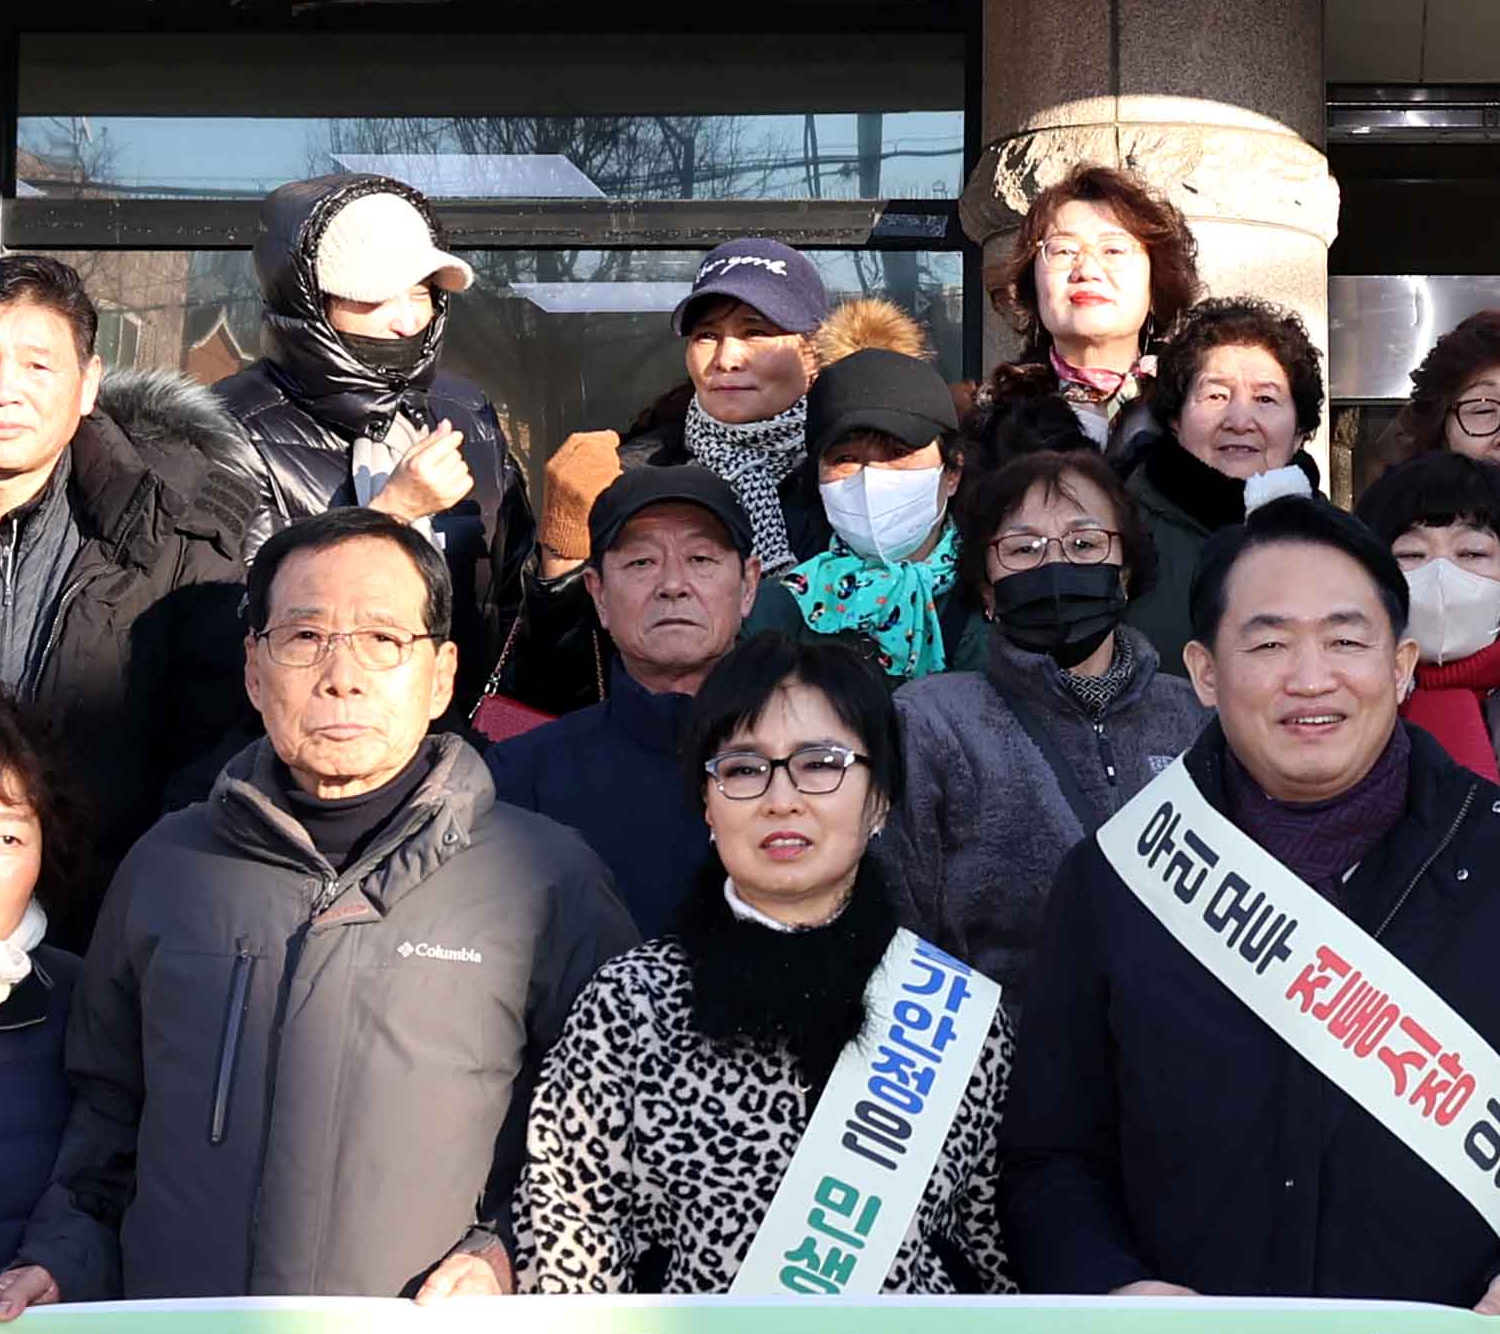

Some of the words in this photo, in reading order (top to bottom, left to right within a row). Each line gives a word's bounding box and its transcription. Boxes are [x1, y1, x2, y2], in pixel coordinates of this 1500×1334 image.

[415, 942, 482, 963] Columbia
[1137, 801, 1220, 905] 우리
[1203, 872, 1298, 975] 모두
[1285, 945, 1476, 1126] 전통시장
[779, 1175, 882, 1294] 민생
